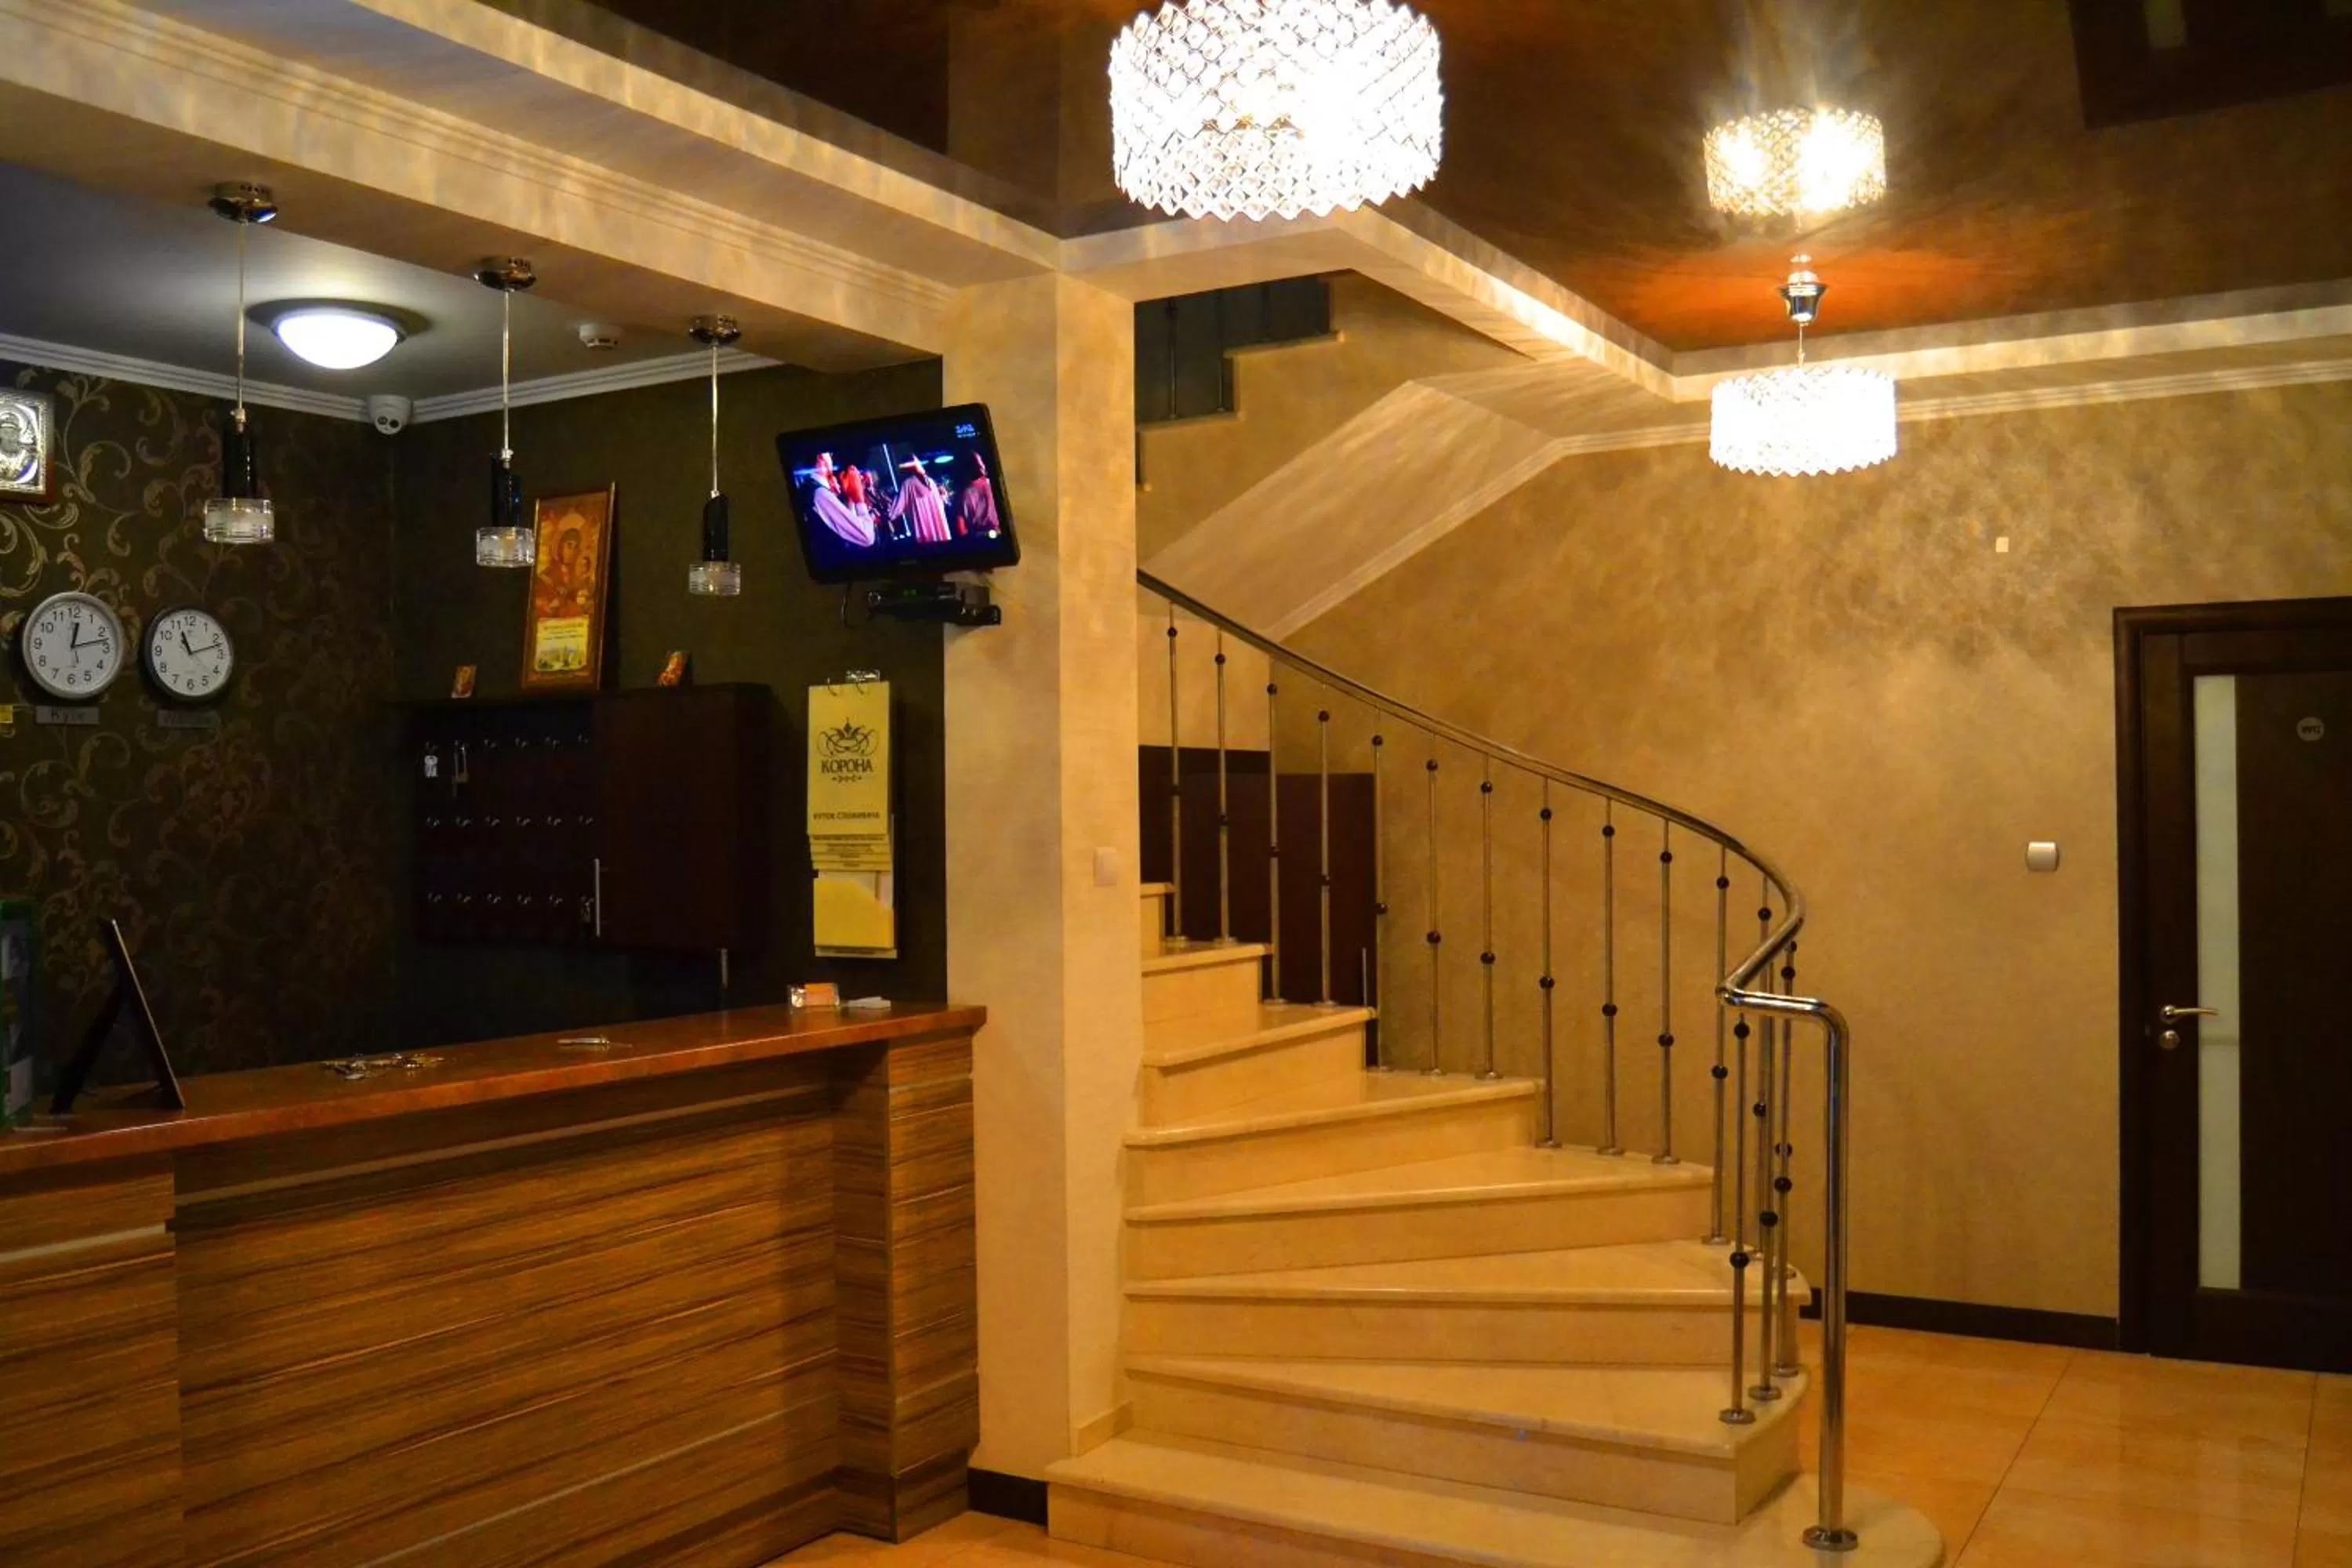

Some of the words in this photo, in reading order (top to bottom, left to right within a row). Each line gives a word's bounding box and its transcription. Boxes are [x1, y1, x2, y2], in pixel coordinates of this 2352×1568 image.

[53, 611, 64, 622] 11
[68, 606, 82, 619] 12
[171, 620, 181, 630] 11
[184, 615, 196, 626] 12
[41, 622, 54, 633] 10
[99, 625, 107, 637] 2
[160, 630, 172, 641] 10
[212, 633, 220, 644] 2
[34, 637, 42, 650] 9
[101, 641, 111, 654] 3
[154, 645, 162, 656] 9
[217, 648, 225, 659] 3
[38, 655, 46, 667] 8
[96, 659, 103, 670] 4
[159, 662, 167, 673] 8
[212, 664, 220, 675] 4
[52, 667, 60, 680] 7
[67, 673, 76, 684] 6
[84, 670, 92, 681] 5
[172, 673, 180, 684] 7
[187, 679, 195, 691] 6
[201, 675, 209, 687] 5
[821, 758, 874, 774] КОРОНА
